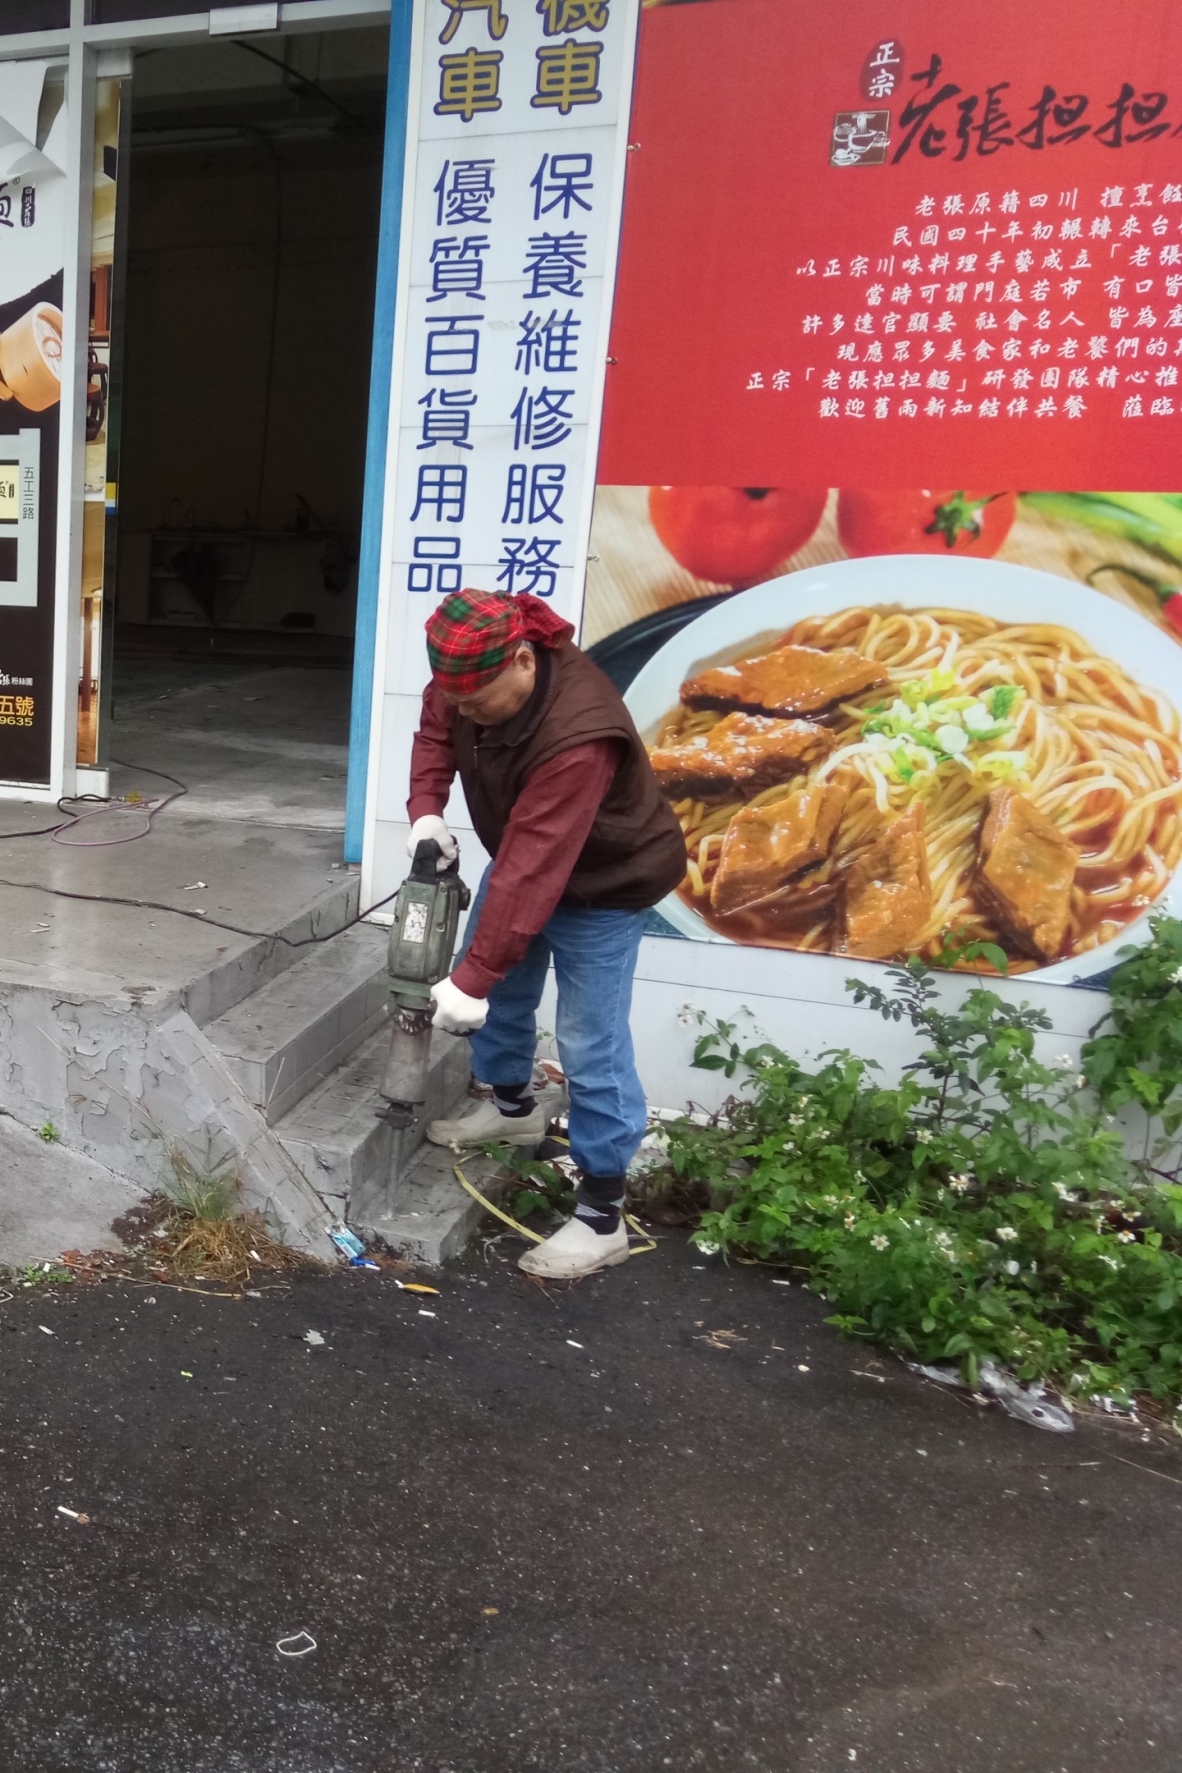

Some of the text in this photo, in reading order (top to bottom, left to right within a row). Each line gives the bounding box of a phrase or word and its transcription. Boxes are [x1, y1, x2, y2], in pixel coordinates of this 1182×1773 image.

[869, 42, 900, 98] 正宗
[890, 53, 1182, 165] 老張担担
[915, 188, 1078, 216] 老張原籍四川
[893, 214, 1182, 247] 民國四十年初輾轉來台
[866, 277, 1082, 305] 當時可謂門庭若市
[802, 311, 957, 335] 許多達官顯要
[975, 308, 1085, 331] 社會名人
[407, 158, 496, 593] 優質百貨用品
[497, 153, 594, 598] 保養維修服務
[818, 394, 1182, 419] 歡迎舊雨新知結伴共餐 蒞臨
[23, 466, 35, 519] 五工三路
